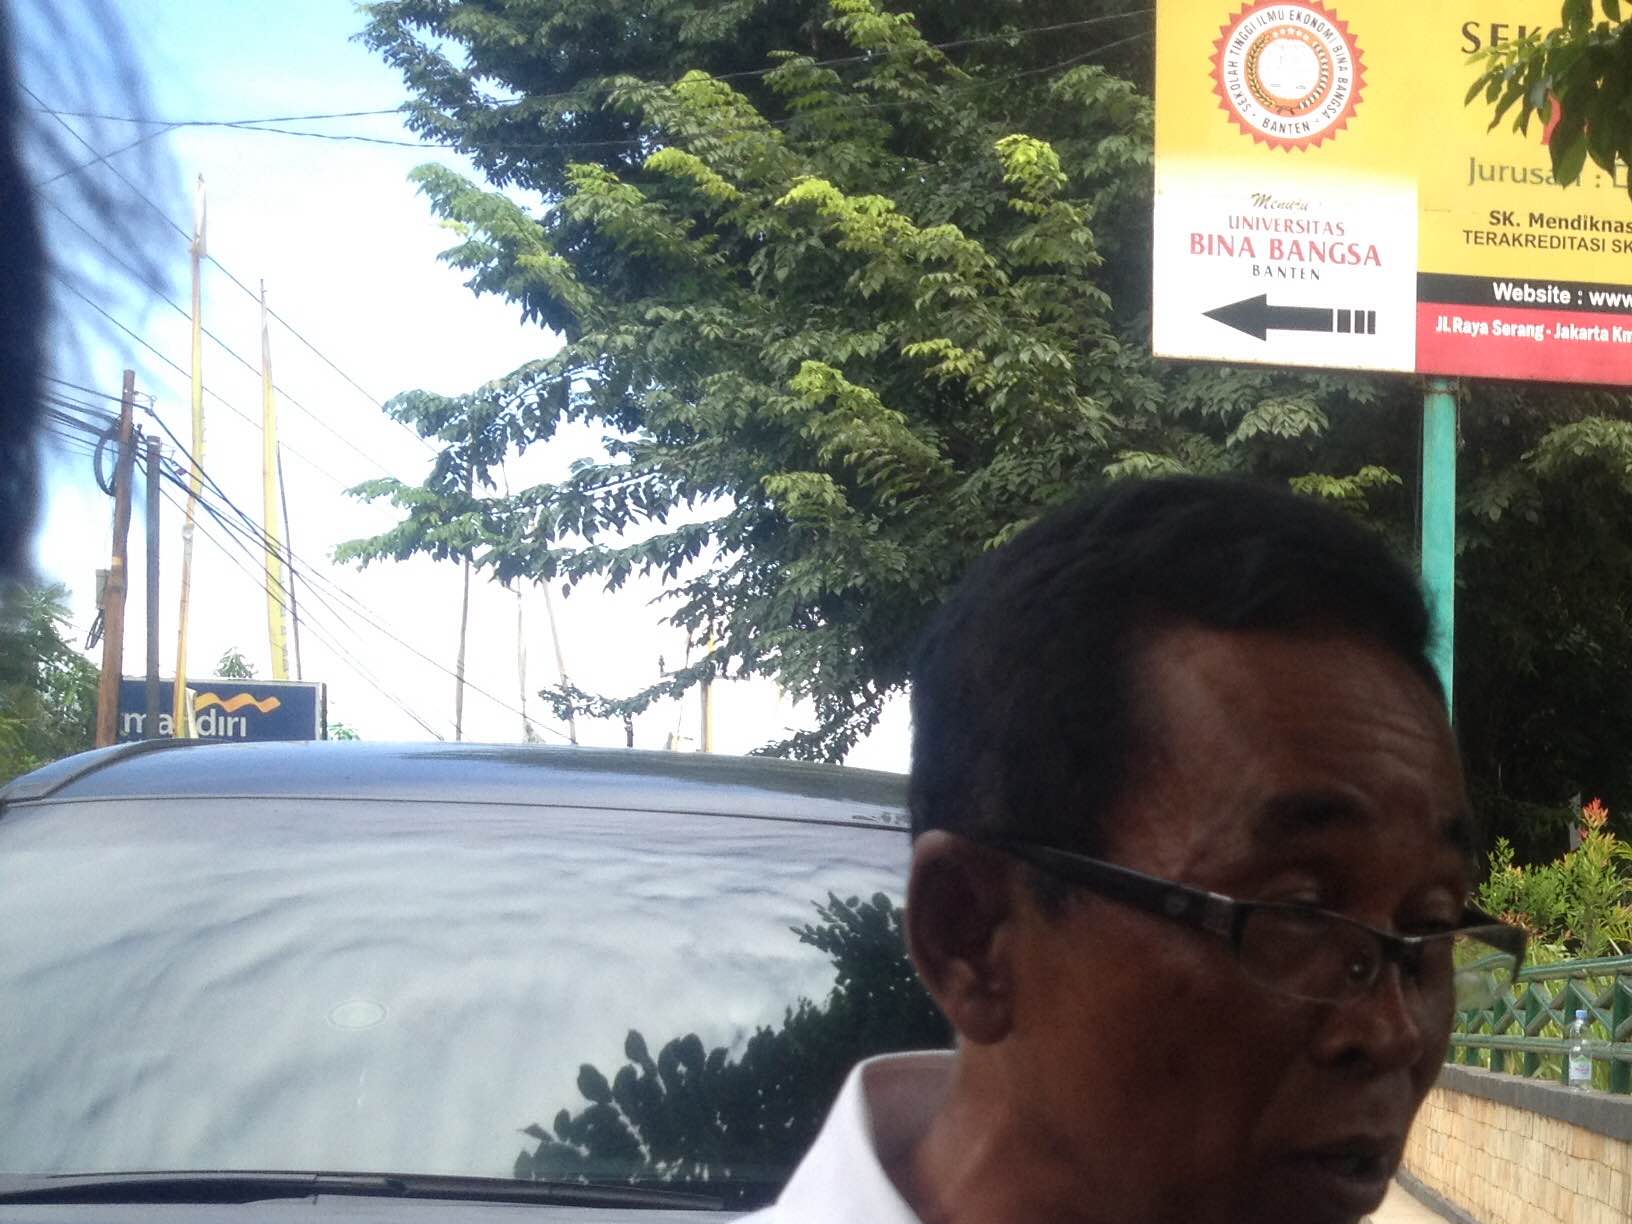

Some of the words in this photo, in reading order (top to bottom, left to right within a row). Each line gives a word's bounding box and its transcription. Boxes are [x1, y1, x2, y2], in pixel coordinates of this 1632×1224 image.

[1257, 10, 1285, 27] ILMU
[1289, 10, 1337, 44] EKONOMI
[1230, 22, 1257, 56] TINGGI
[1332, 45, 1348, 72] BINA
[1228, 60, 1251, 113] SEKOLAH
[1321, 77, 1348, 119] BANGSA
[1262, 117, 1310, 134] BANTEN
[1228, 215, 1345, 236] UNIVERSITAS
[1489, 210, 1520, 227] SK.
[1190, 233, 1256, 258] BINA
[1269, 238, 1382, 267] BANGSA
[1463, 230, 1606, 253] TERAKREDITASI
[1252, 264, 1320, 280] BANTEN
[1493, 282, 1571, 304] Website
[1492, 319, 1545, 341] Serang
[1554, 322, 1609, 342] Jakarta
[123, 709, 247, 737] madiri
